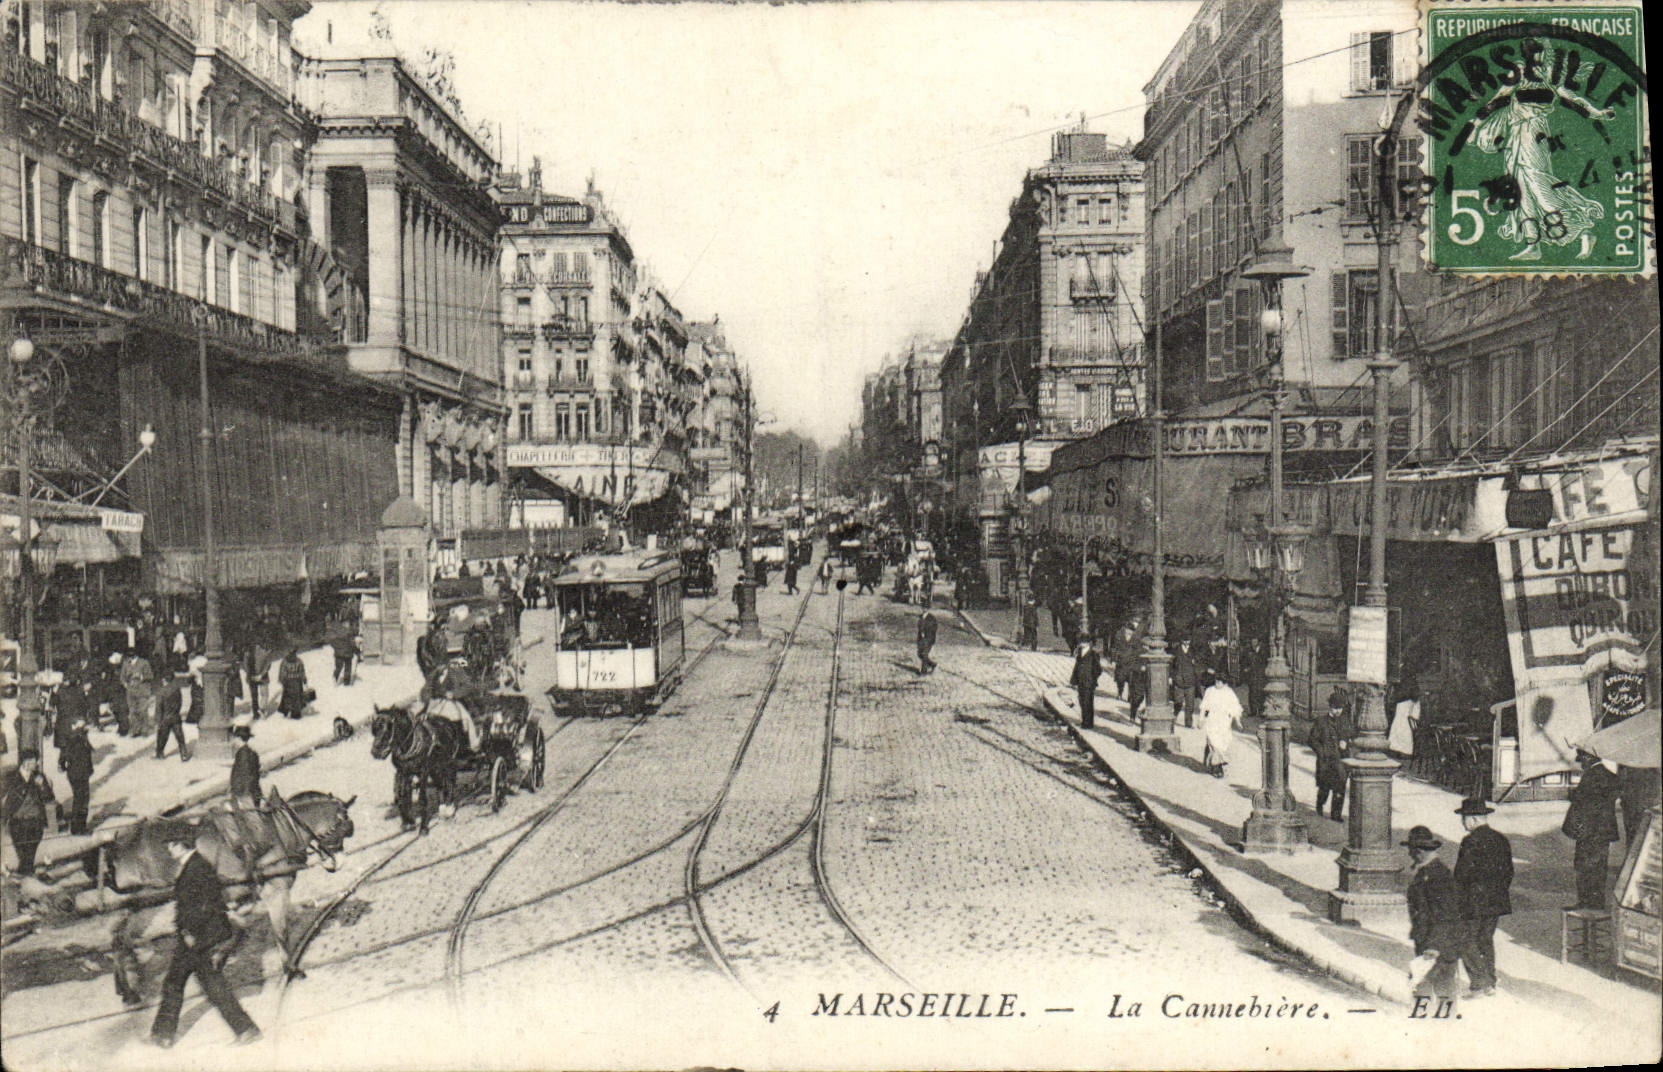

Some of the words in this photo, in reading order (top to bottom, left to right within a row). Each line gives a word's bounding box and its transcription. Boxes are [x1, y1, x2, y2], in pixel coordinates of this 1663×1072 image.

[543, 206, 588, 222] CONFECTIONS
[1614, 170, 1635, 257] POSTES
[1531, 530, 1624, 571] CAFE
[592, 671, 617, 682] 722
